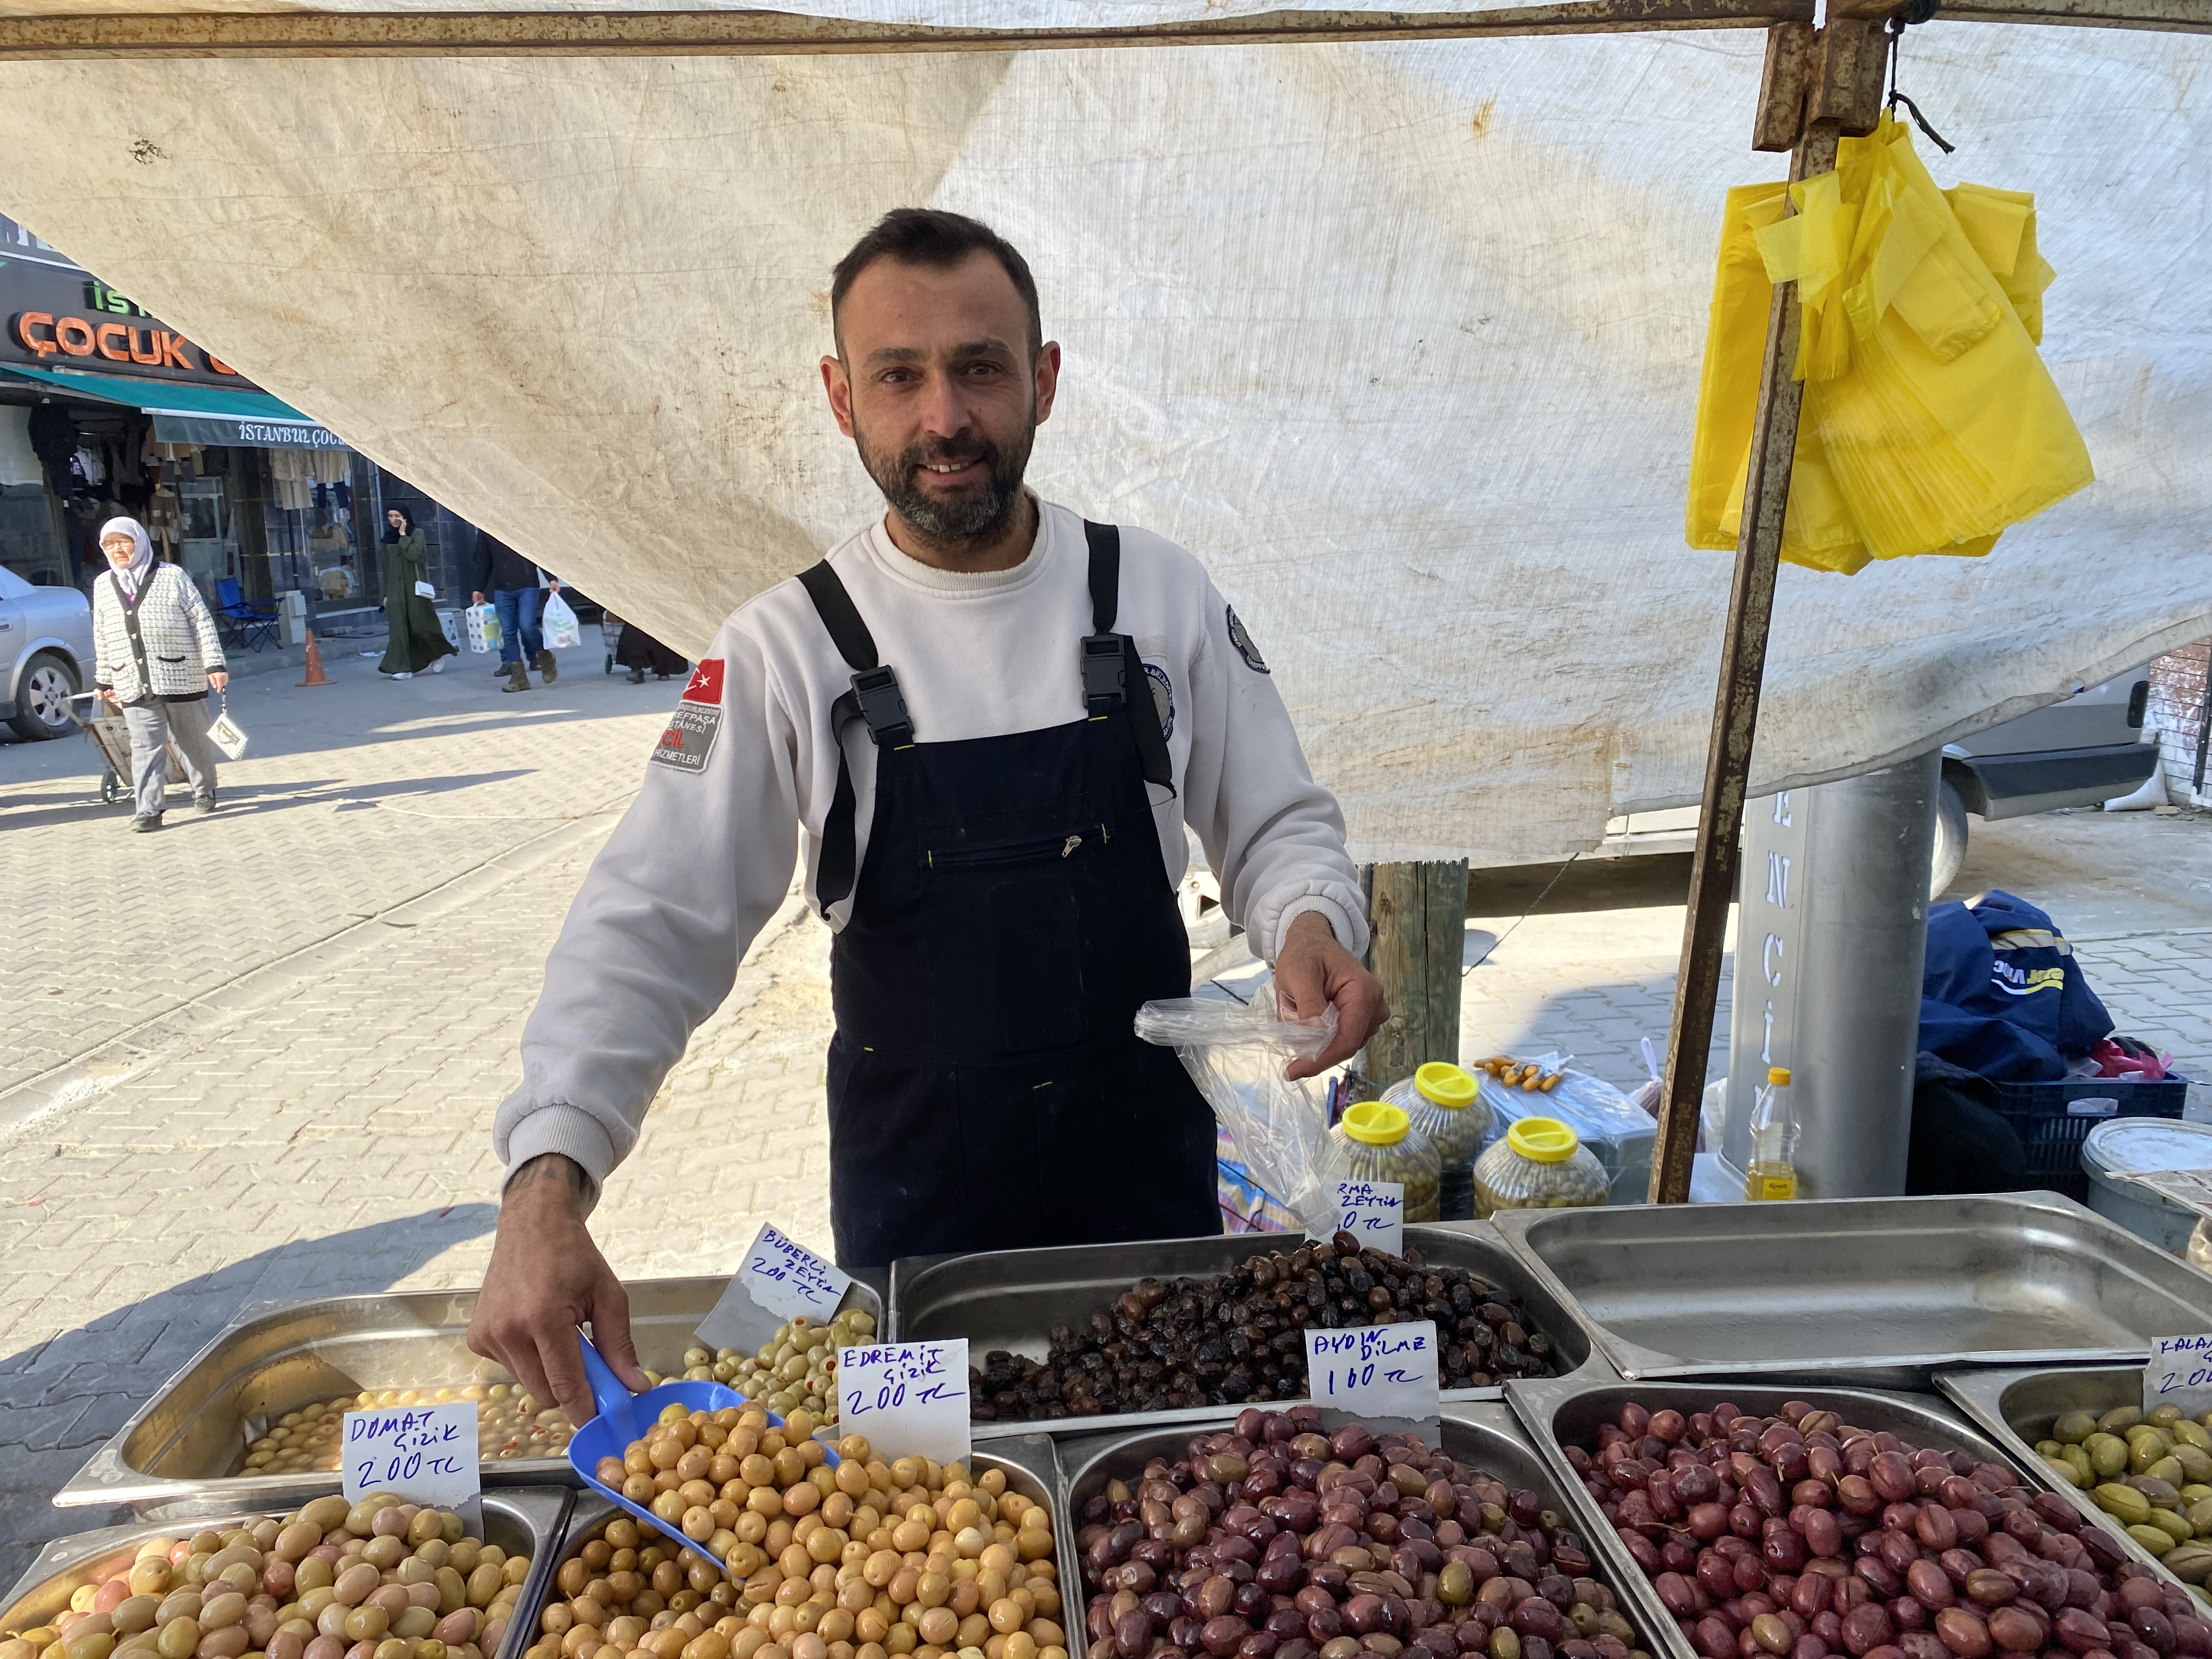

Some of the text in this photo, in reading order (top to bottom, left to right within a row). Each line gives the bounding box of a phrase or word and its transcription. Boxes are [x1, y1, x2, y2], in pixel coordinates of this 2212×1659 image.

[19, 311, 195, 369] ÇOCUK
[239, 421, 311, 444] İSTANBUL
[654, 748, 701, 765] HİZMETLERİ
[1337, 1183, 1373, 1195] RMA
[752, 1257, 786, 1281] 200
[847, 1383, 905, 1415] 200
[351, 1410, 435, 1442] DOMAT
[358, 1452, 464, 1488] 200 TL
